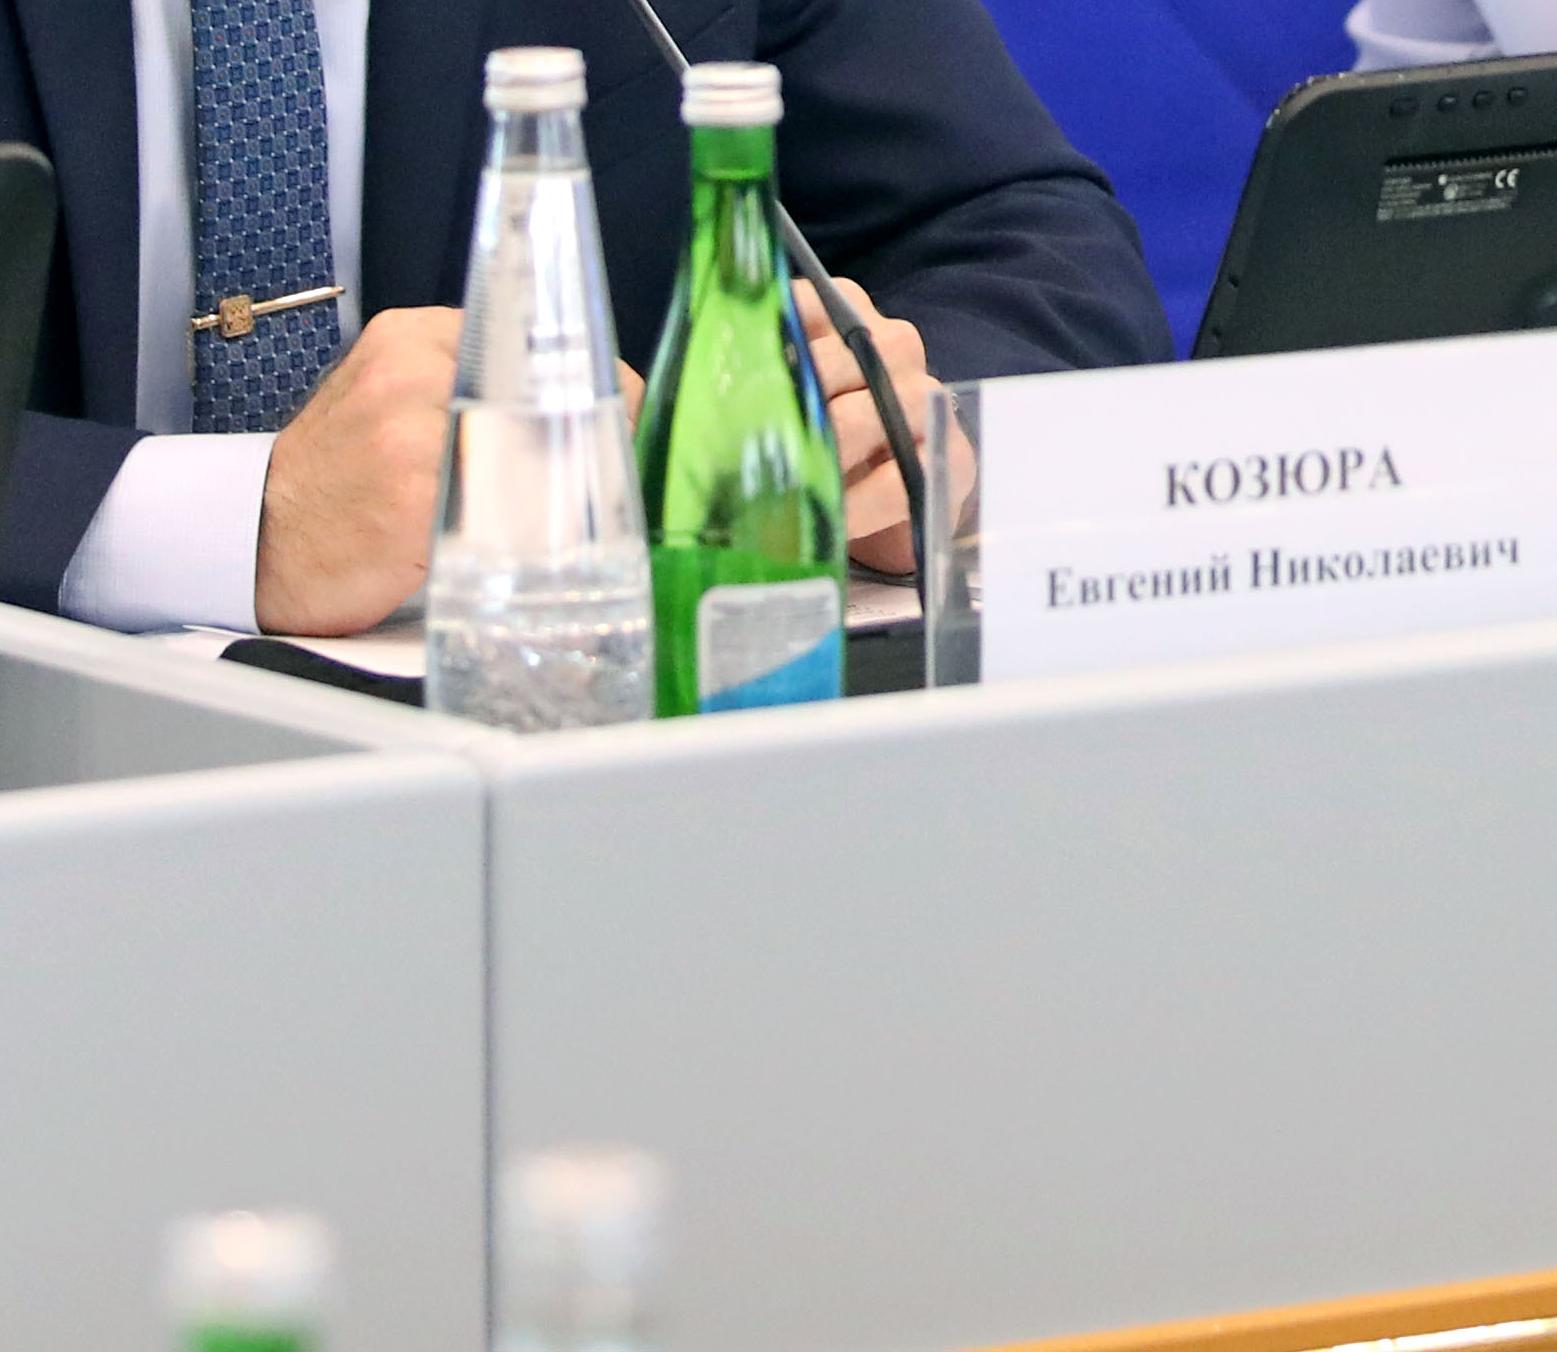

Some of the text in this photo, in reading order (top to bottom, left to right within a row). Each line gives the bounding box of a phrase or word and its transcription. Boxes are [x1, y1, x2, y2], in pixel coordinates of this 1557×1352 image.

[1164, 447, 1402, 507] КОЗЮРА
[1047, 537, 1520, 609] Евгений Николаевич
